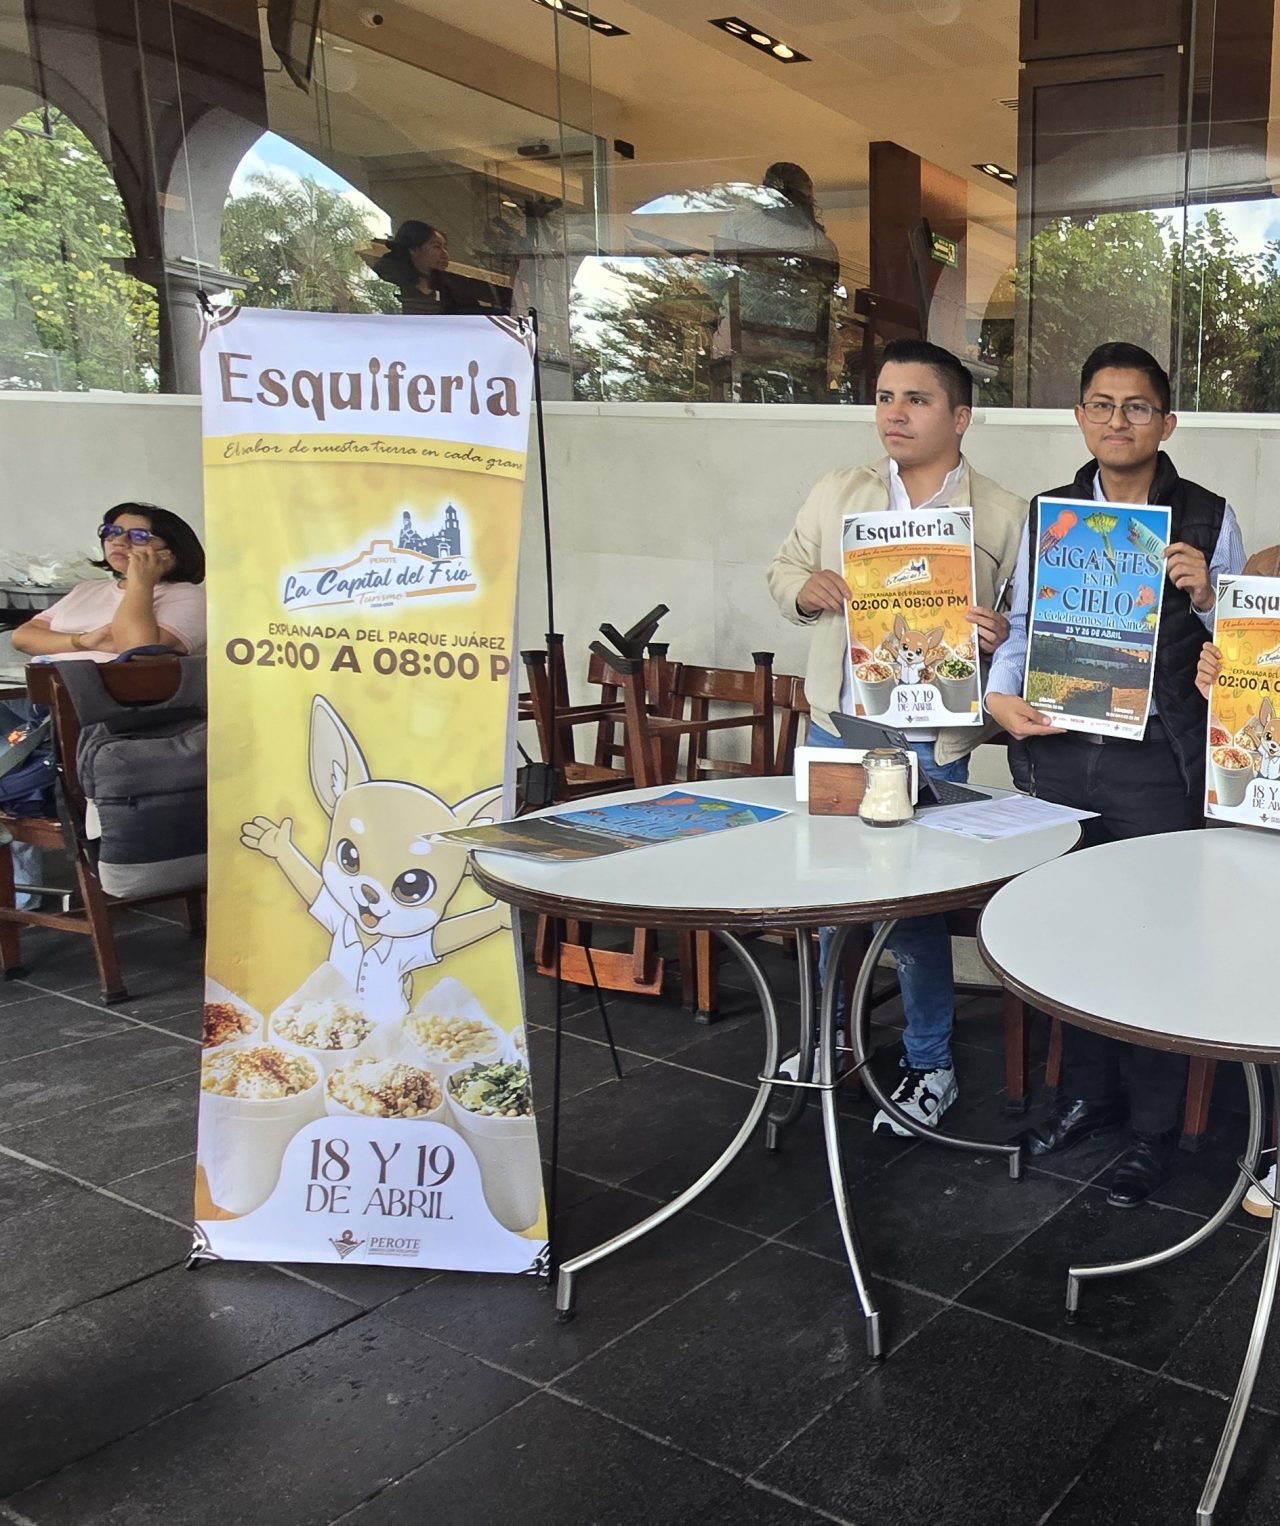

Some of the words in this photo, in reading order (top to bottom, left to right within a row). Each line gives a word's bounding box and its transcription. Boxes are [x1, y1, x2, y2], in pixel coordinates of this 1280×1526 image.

[218, 351, 521, 421] Esquiferia
[288, 440, 310, 454] de
[312, 439, 369, 453] nuestra
[371, 440, 418, 455] tierra
[421, 448, 439, 458] en
[444, 447, 484, 463] cada
[855, 518, 956, 543] Esquiferia
[1044, 546, 1160, 576] GIGANTES
[283, 575, 312, 604] La
[316, 567, 392, 598] Capital
[396, 565, 427, 585] del
[428, 560, 472, 584] Frío
[851, 599, 889, 611] 02:00
[892, 599, 901, 609] A
[904, 597, 944, 609] 08:00
[947, 595, 969, 607] PM
[1062, 587, 1134, 617] CIELO
[1043, 610, 1102, 627] Celebremos
[268, 623, 351, 640] EXPLANADA
[356, 629, 385, 643] DEL
[388, 630, 448, 647] PARQUE
[451, 631, 506, 651] JUÁREZ
[1075, 626, 1081, 634] Y
[1090, 629, 1100, 637] DE
[1101, 630, 1122, 640] ABRIL
[225, 638, 321, 671] 02:00
[329, 644, 363, 674] A
[372, 647, 481, 681] 08:00
[1218, 674, 1258, 690] 02:00
[1260, 679, 1270, 692] A
[1232, 668, 1267, 679] EXPLANADA
[897, 690, 908, 704] 18
[911, 690, 920, 703] Y
[923, 690, 934, 702] 19
[1253, 785, 1265, 799] 18
[1269, 786, 1279, 801] Y
[310, 1137, 351, 1182] 18
[368, 1140, 402, 1185] Y
[416, 1143, 456, 1187] 19
[305, 1183, 352, 1214] DE
[362, 1187, 454, 1221] ABRIL
[370, 1236, 421, 1249] PEROTE
